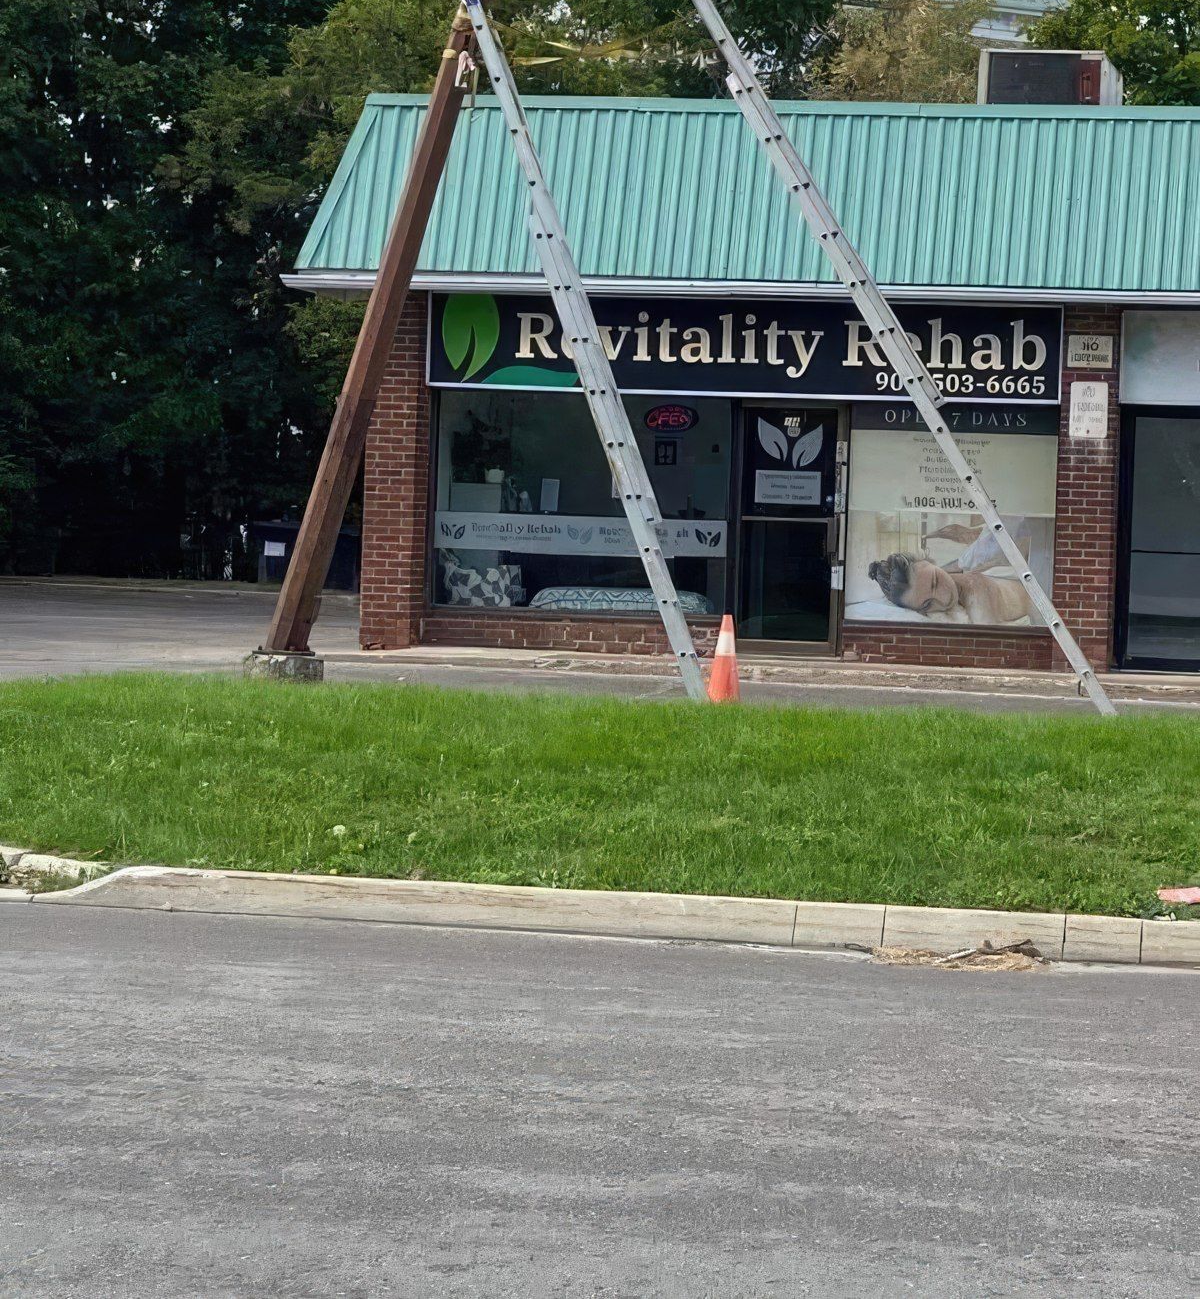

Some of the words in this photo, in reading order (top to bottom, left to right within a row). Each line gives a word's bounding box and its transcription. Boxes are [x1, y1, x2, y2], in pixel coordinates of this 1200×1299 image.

[515, 311, 824, 378] Rvitality
[875, 372, 1046, 396] 90503-6665
[951, 412, 962, 428] 7
[972, 411, 1028, 428] DAYS
